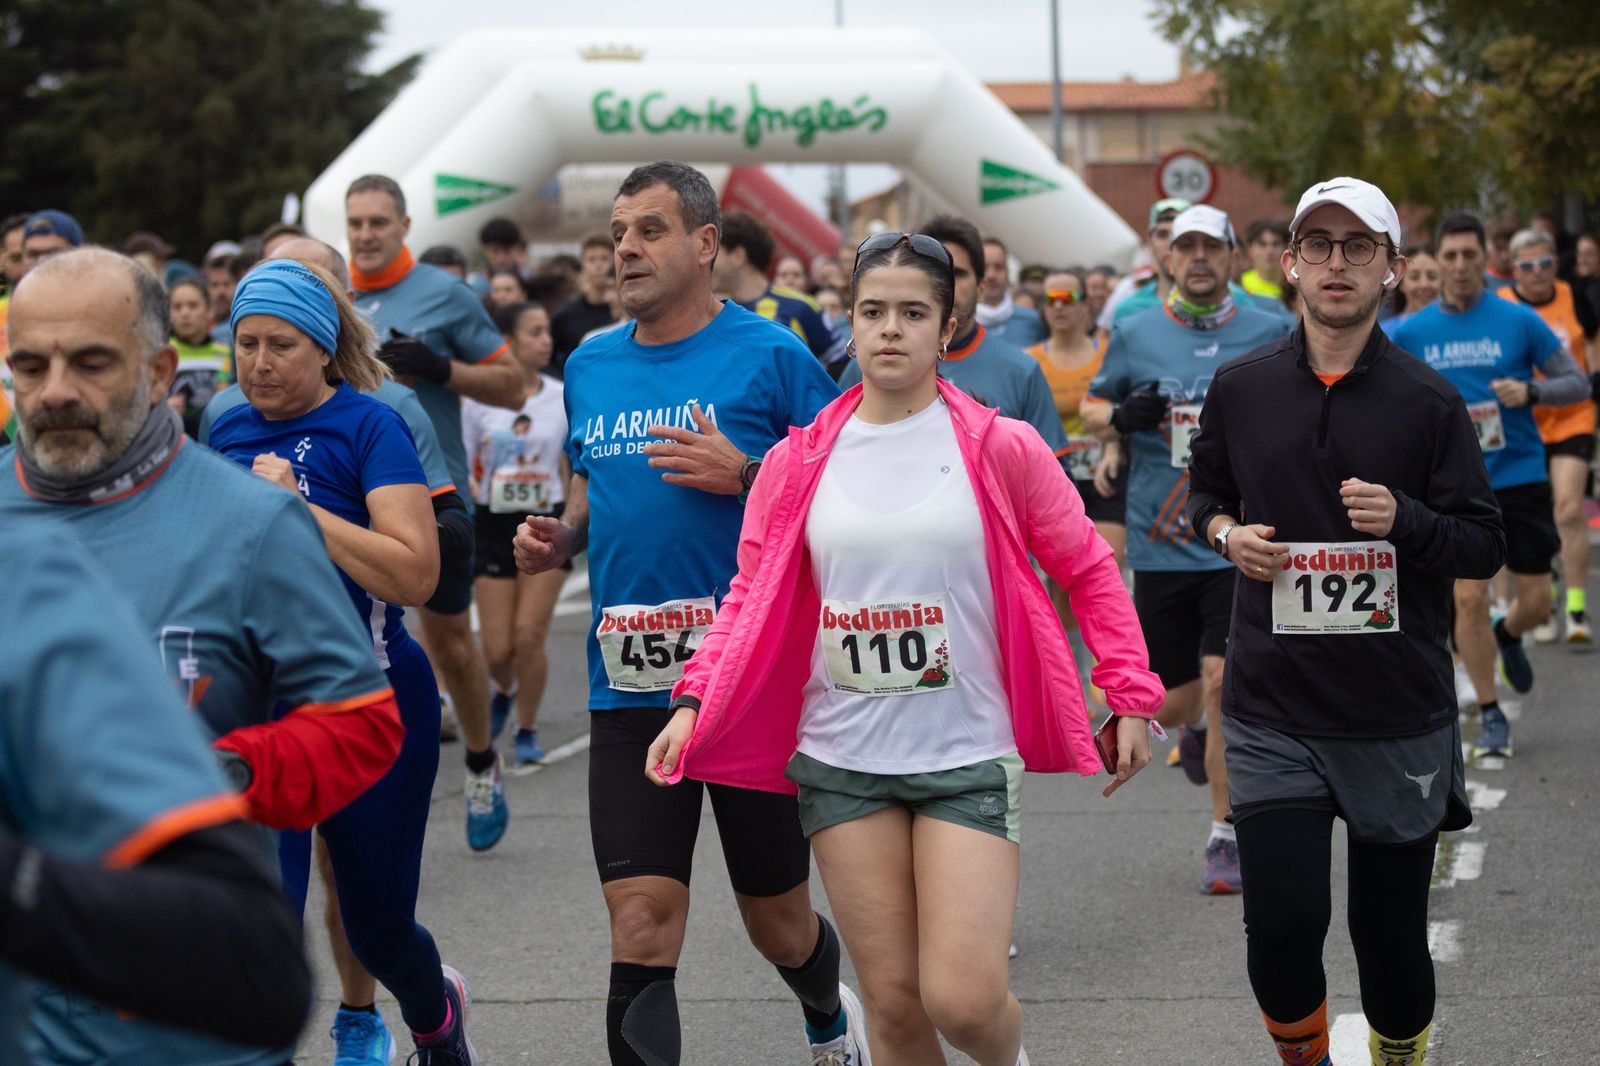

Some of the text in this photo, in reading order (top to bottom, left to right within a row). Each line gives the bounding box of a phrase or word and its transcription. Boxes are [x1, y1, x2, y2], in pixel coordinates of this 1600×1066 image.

[592, 82, 887, 148] El Corte Inglés
[1169, 166, 1204, 192] 30
[1424, 336, 1502, 363] LA ARMUÑA
[584, 414, 605, 446] LA
[591, 444, 622, 460] CLUB
[503, 483, 542, 501] 551
[1295, 573, 1377, 612] 192
[599, 605, 714, 633] bedunia
[822, 603, 944, 631] bedunia
[841, 630, 928, 674] 110
